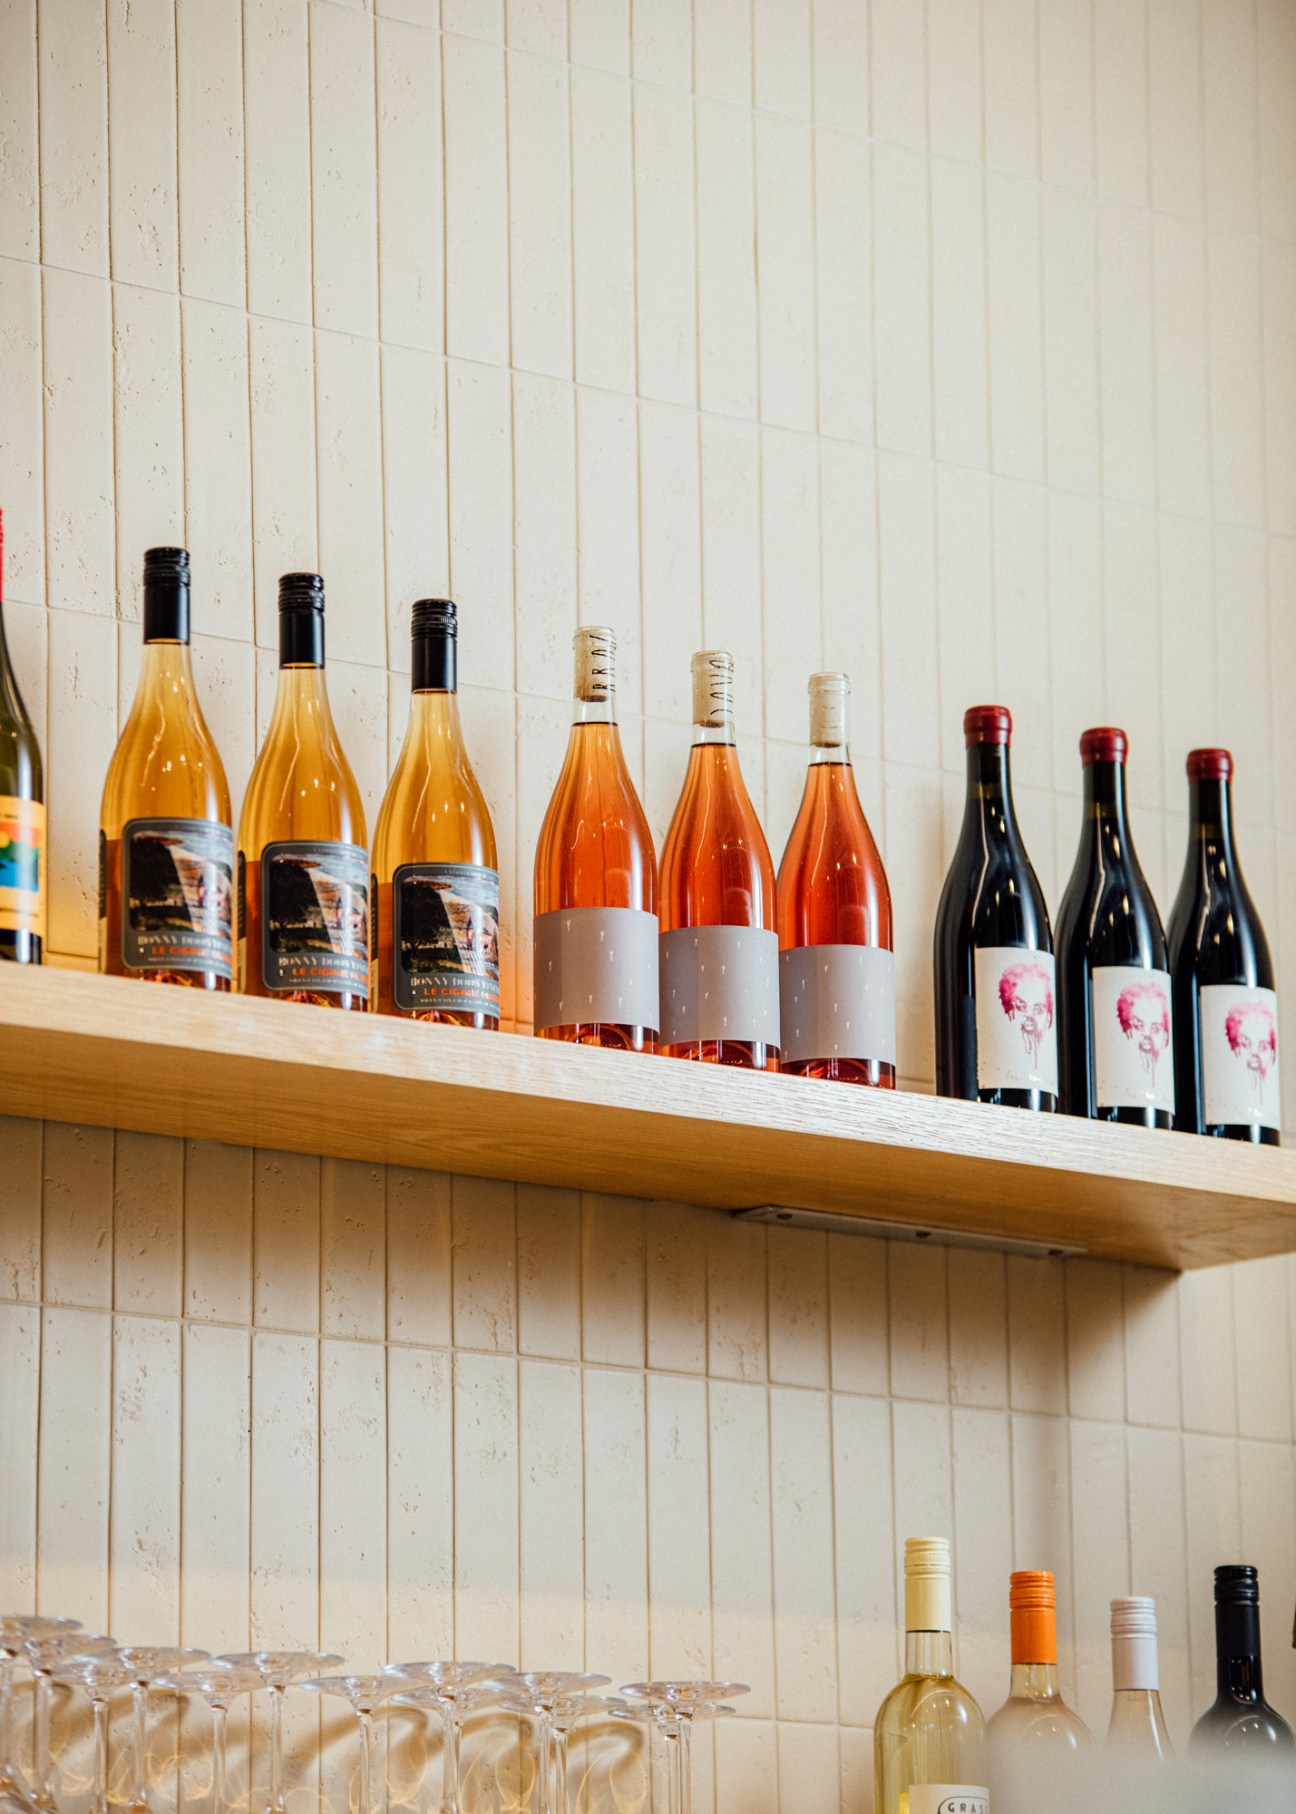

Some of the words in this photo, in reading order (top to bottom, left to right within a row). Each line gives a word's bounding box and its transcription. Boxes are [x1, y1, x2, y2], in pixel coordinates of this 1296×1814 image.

[152, 946, 166, 955] LE
[292, 967, 306, 977] LE
[410, 977, 448, 987] BONNY
[424, 987, 438, 997] LE
[441, 987, 480, 999] CIGARE
